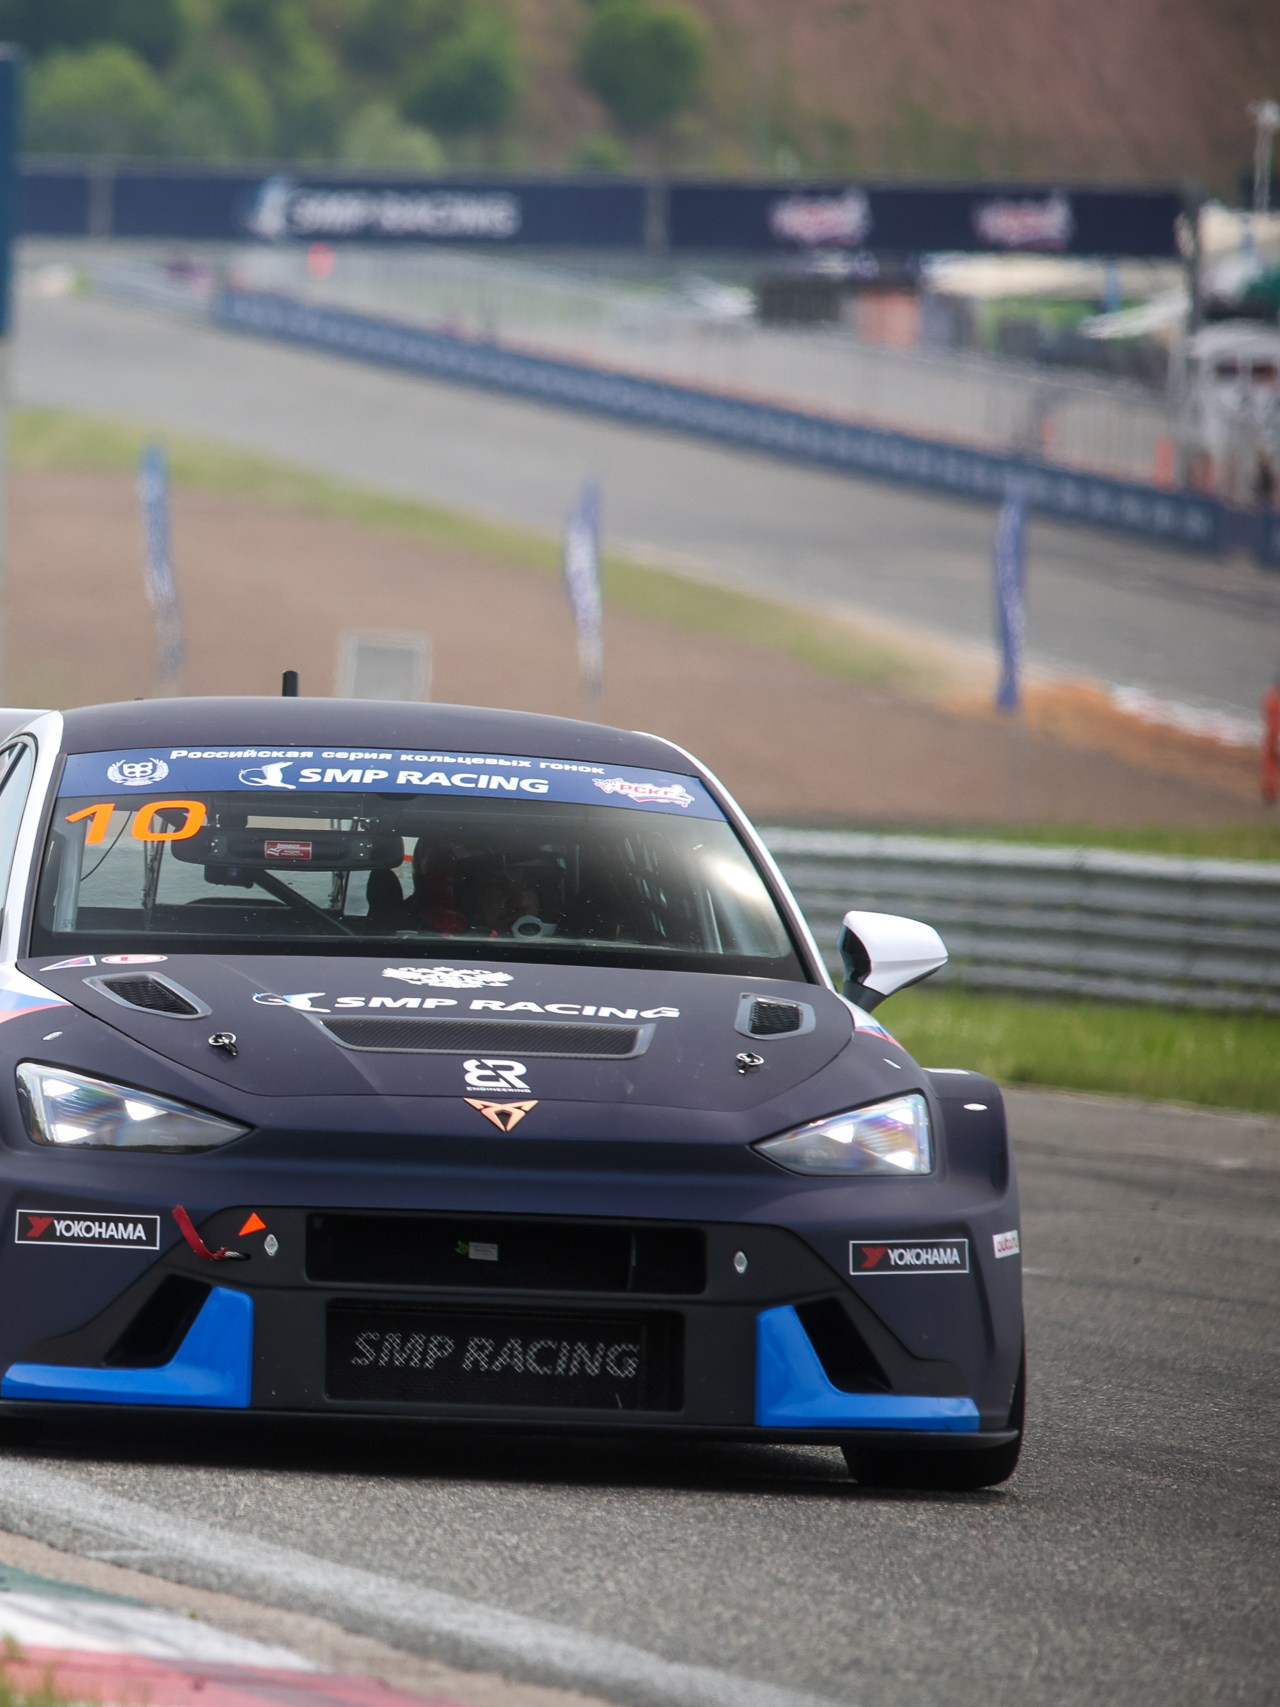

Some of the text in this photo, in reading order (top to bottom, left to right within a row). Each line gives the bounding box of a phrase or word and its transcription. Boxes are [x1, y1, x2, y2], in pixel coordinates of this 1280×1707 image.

[169, 749, 606, 775] Российская серия кольцевых гонок
[298, 768, 550, 794] SMP RACING
[619, 783, 674, 796] РСКГ
[65, 800, 208, 845] 10
[334, 996, 681, 1020] SMP RACING
[53, 1219, 147, 1241] YOKOHAMA
[887, 1247, 961, 1266] YOKOHAMA
[351, 1331, 640, 1378] SMP RACING
